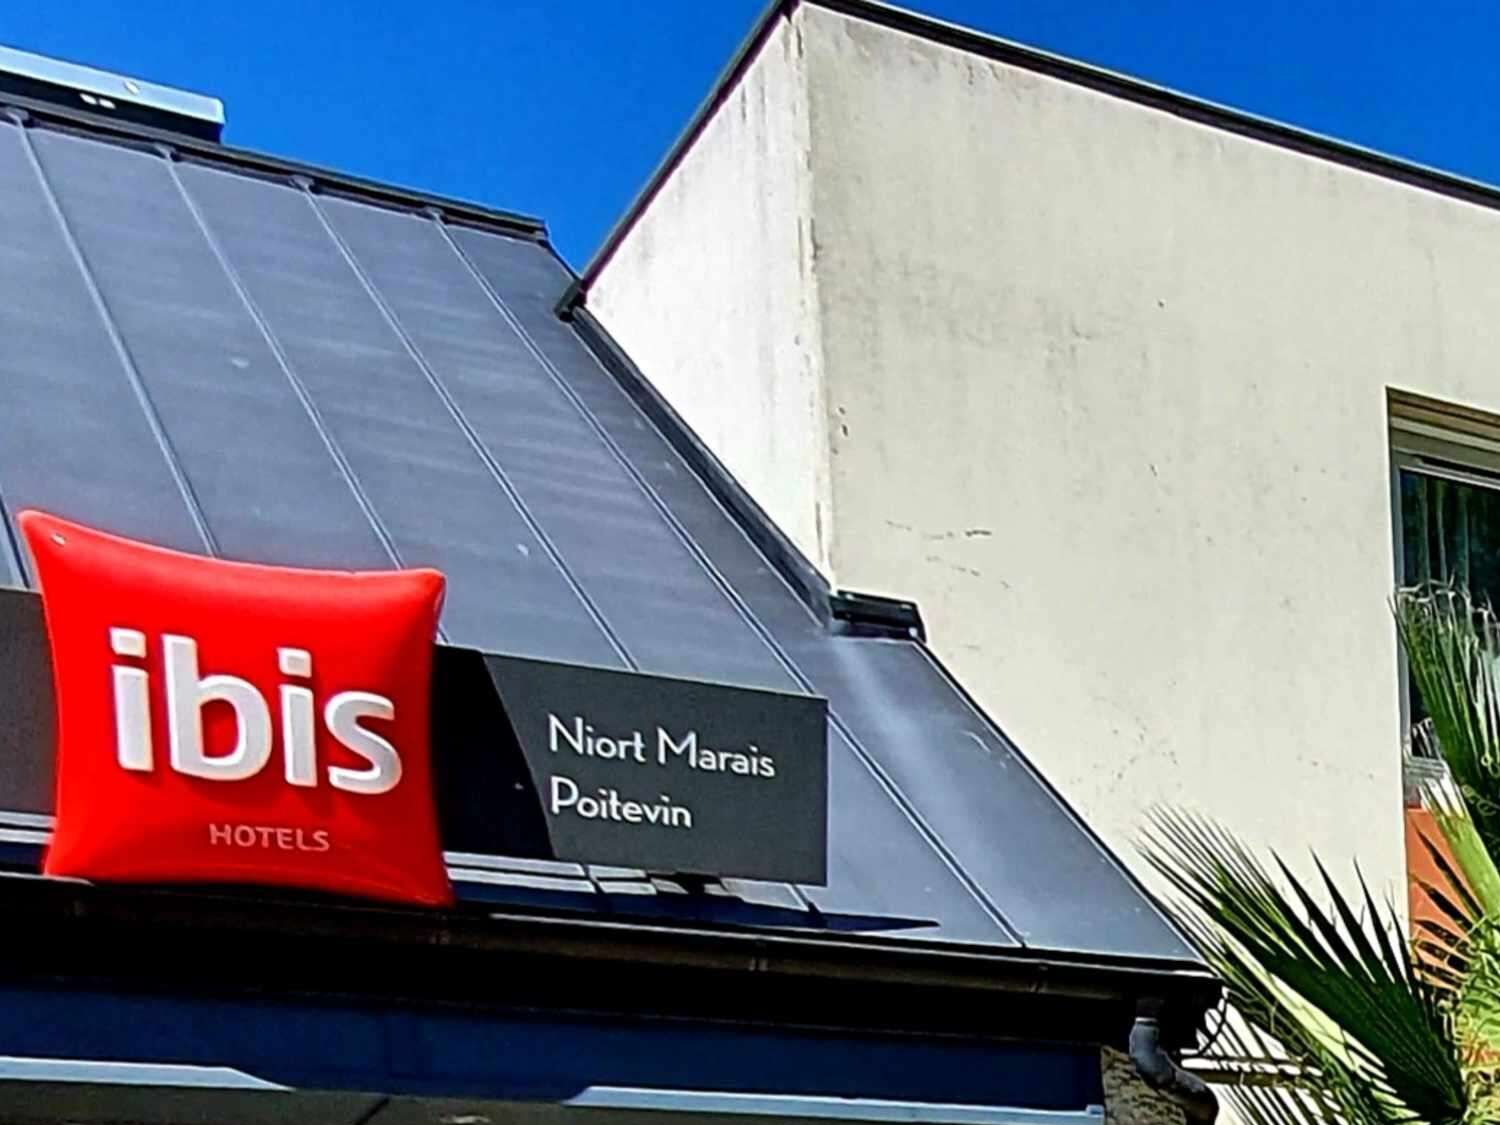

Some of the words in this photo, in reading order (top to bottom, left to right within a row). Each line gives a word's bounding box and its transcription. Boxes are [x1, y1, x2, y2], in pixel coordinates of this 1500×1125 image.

[110, 627, 402, 794] ibis
[548, 714, 645, 763] Niort
[657, 726, 776, 778] Marais
[551, 776, 692, 828] Poitevin
[210, 823, 330, 852] HOTELS
